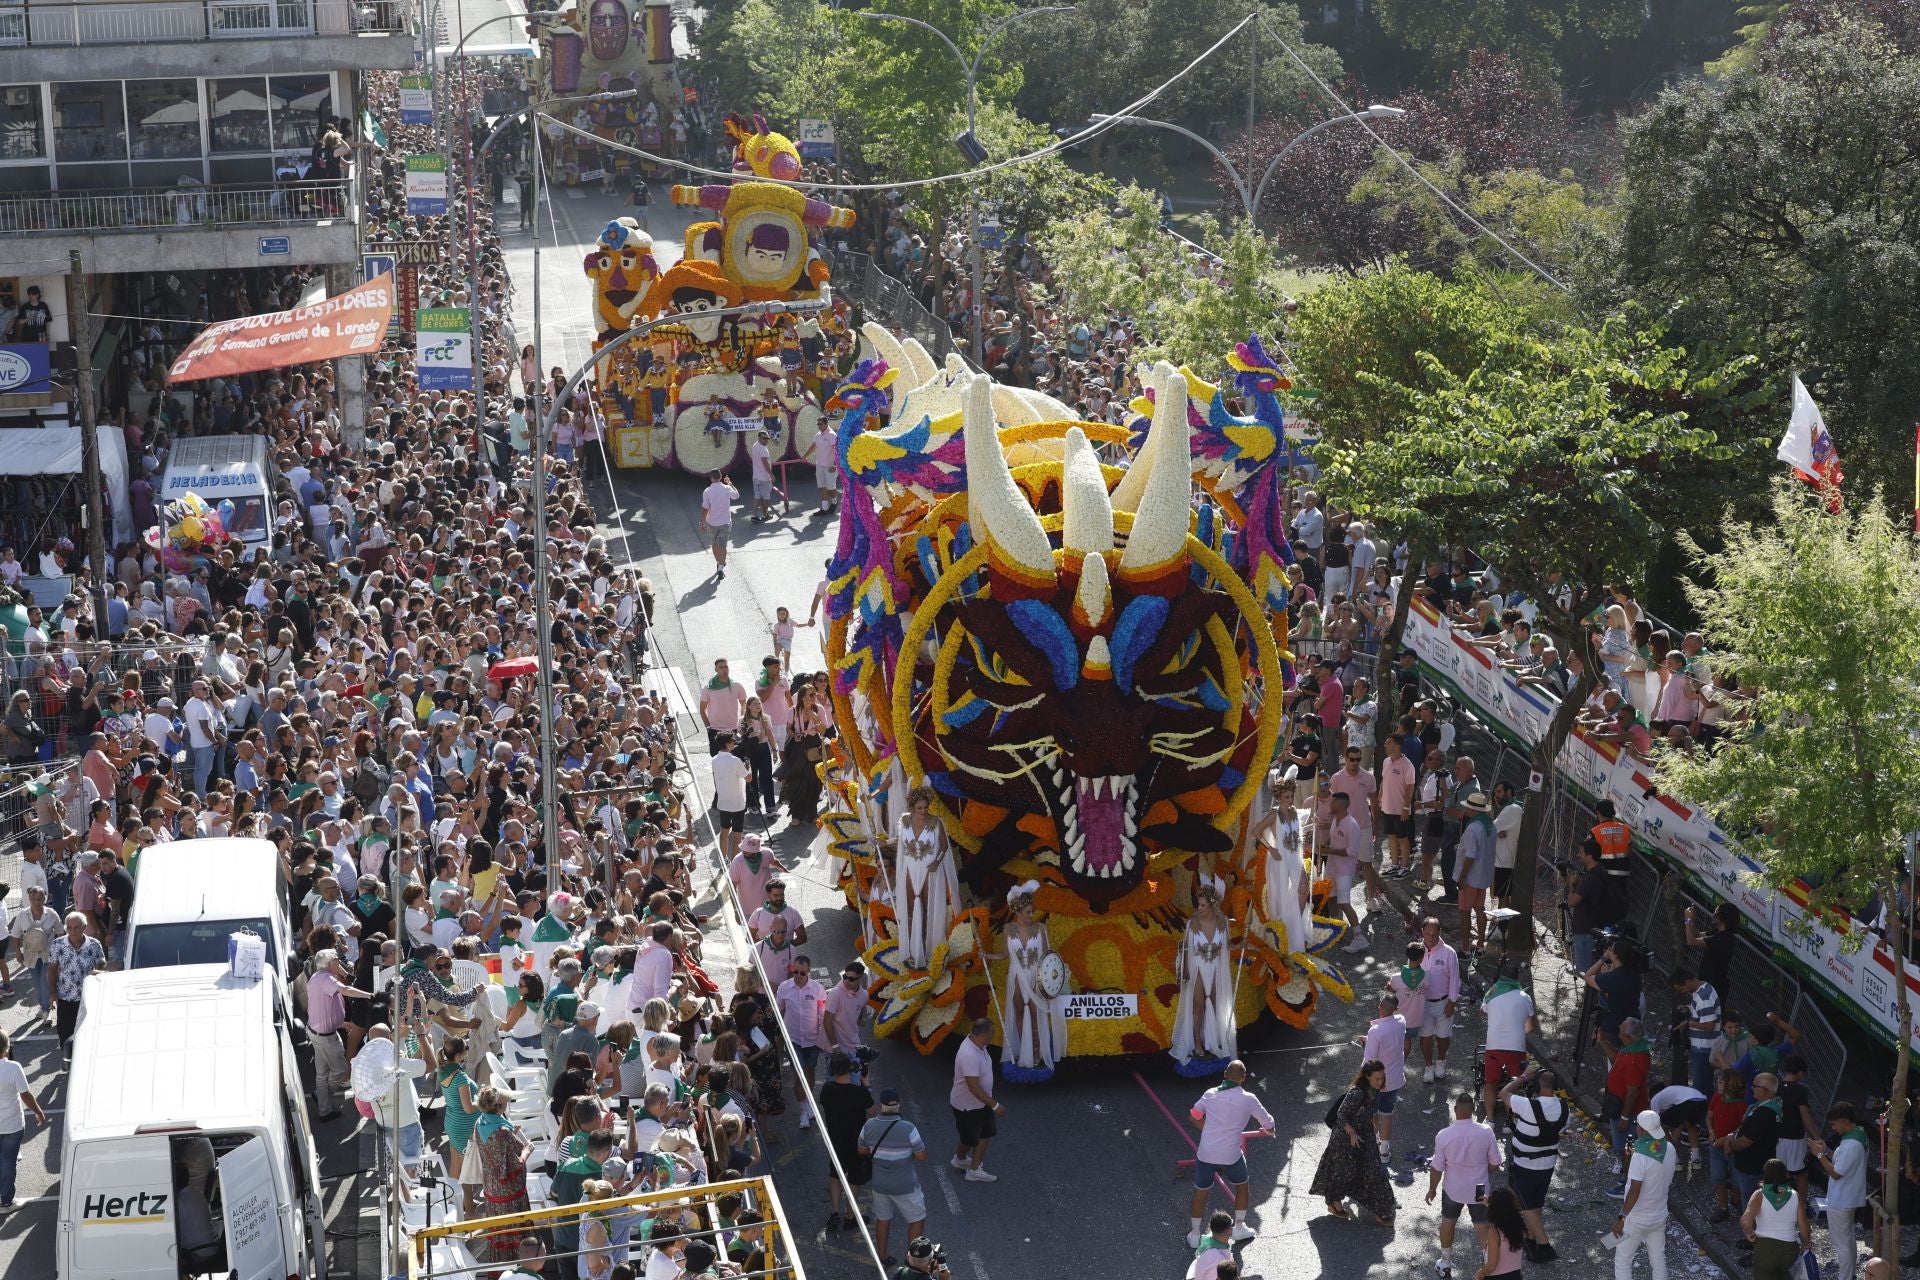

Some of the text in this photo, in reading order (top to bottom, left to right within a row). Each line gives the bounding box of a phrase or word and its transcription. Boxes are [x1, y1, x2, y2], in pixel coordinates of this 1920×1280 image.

[203, 313, 271, 340] MERCADO
[274, 310, 292, 324] DE
[326, 288, 388, 313] FLORES
[421, 313, 464, 322] BATALLA
[434, 320, 464, 328] FLORES
[220, 336, 267, 352] Semana
[268, 327, 309, 345] Grande
[311, 322, 331, 338] de
[336, 318, 380, 337] Laredo
[0, 357, 18, 365] UELA
[424, 346, 455, 362] FCC
[628, 437, 643, 457] 2
[169, 472, 258, 489] HELADERIA
[1644, 819, 1661, 840] FCC
[1806, 936, 1821, 960] FCC
[1069, 996, 1125, 1008] ANILLOS
[1865, 986, 1882, 1004] HOMES
[1064, 1006, 1131, 1018] DE PODER
[83, 1191, 168, 1219] Hertz
[232, 1195, 257, 1219] ALQUILER
[233, 1218, 241, 1229] DE
[239, 1225, 248, 1238] 917
